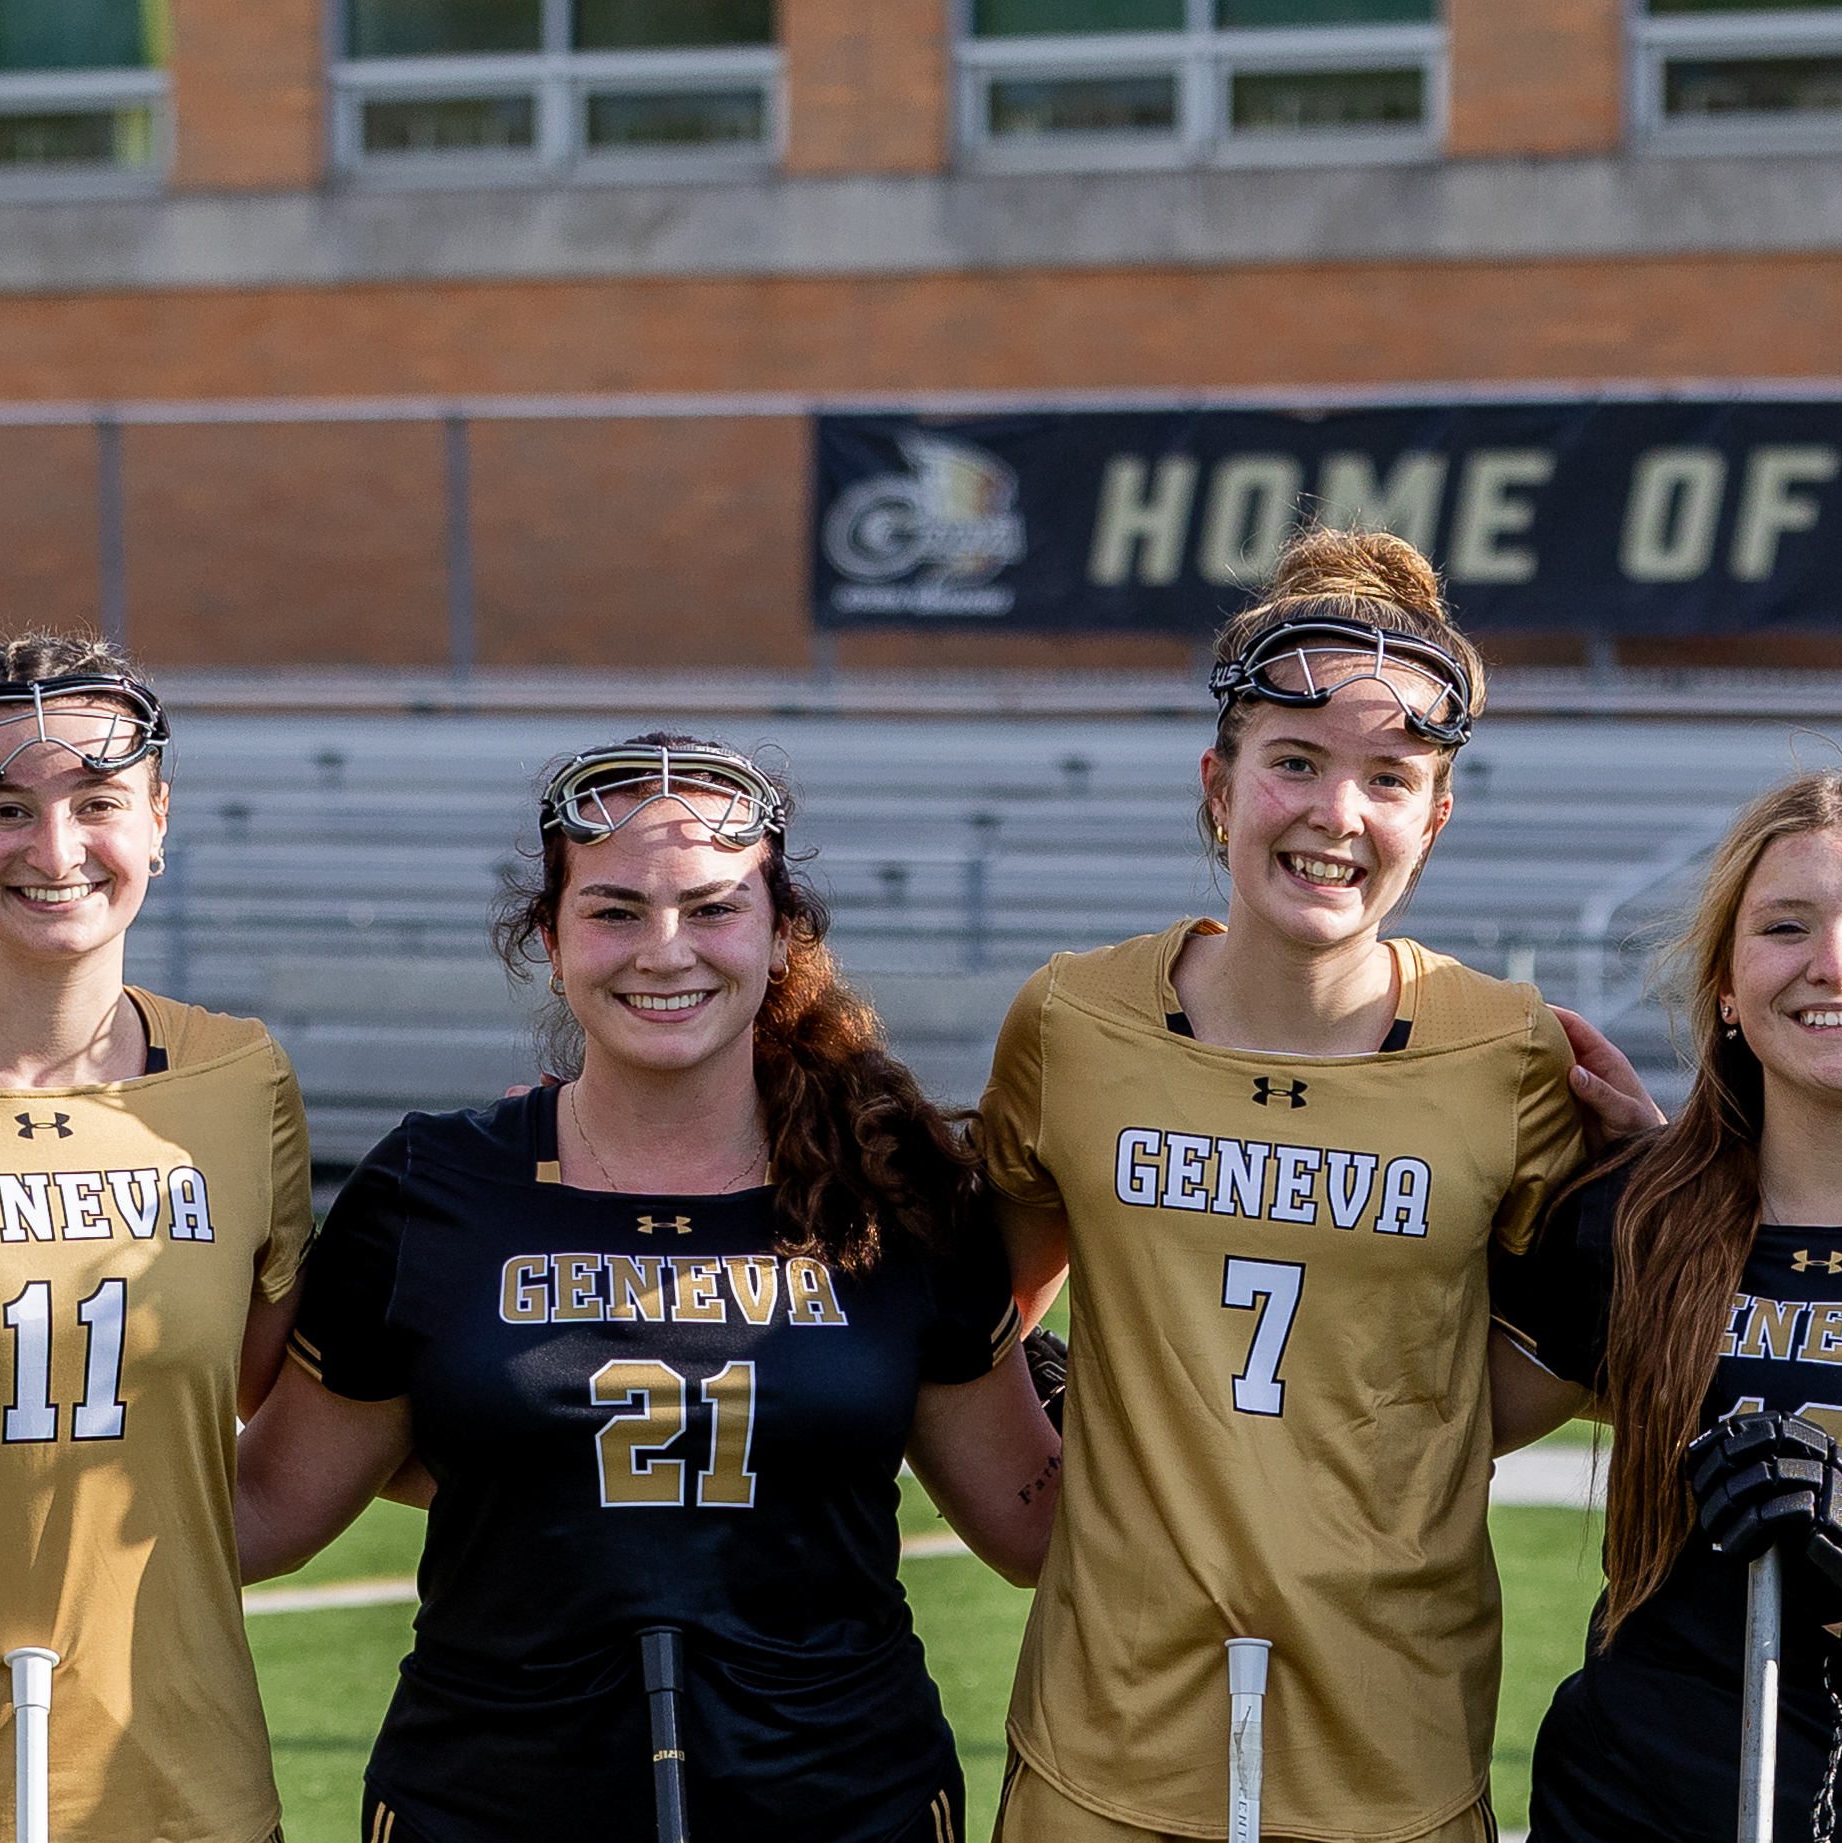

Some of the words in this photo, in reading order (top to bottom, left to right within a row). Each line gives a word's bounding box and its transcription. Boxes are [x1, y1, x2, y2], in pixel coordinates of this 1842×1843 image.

[1089, 448, 1557, 588] HOME
[1618, 446, 1842, 582] OF
[1115, 1127, 1432, 1238] GENEVA
[2, 1278, 128, 1444] 11
[499, 1252, 849, 1326] GENEVA
[1221, 1254, 1306, 1418] 7
[589, 1359, 757, 1508] 21
